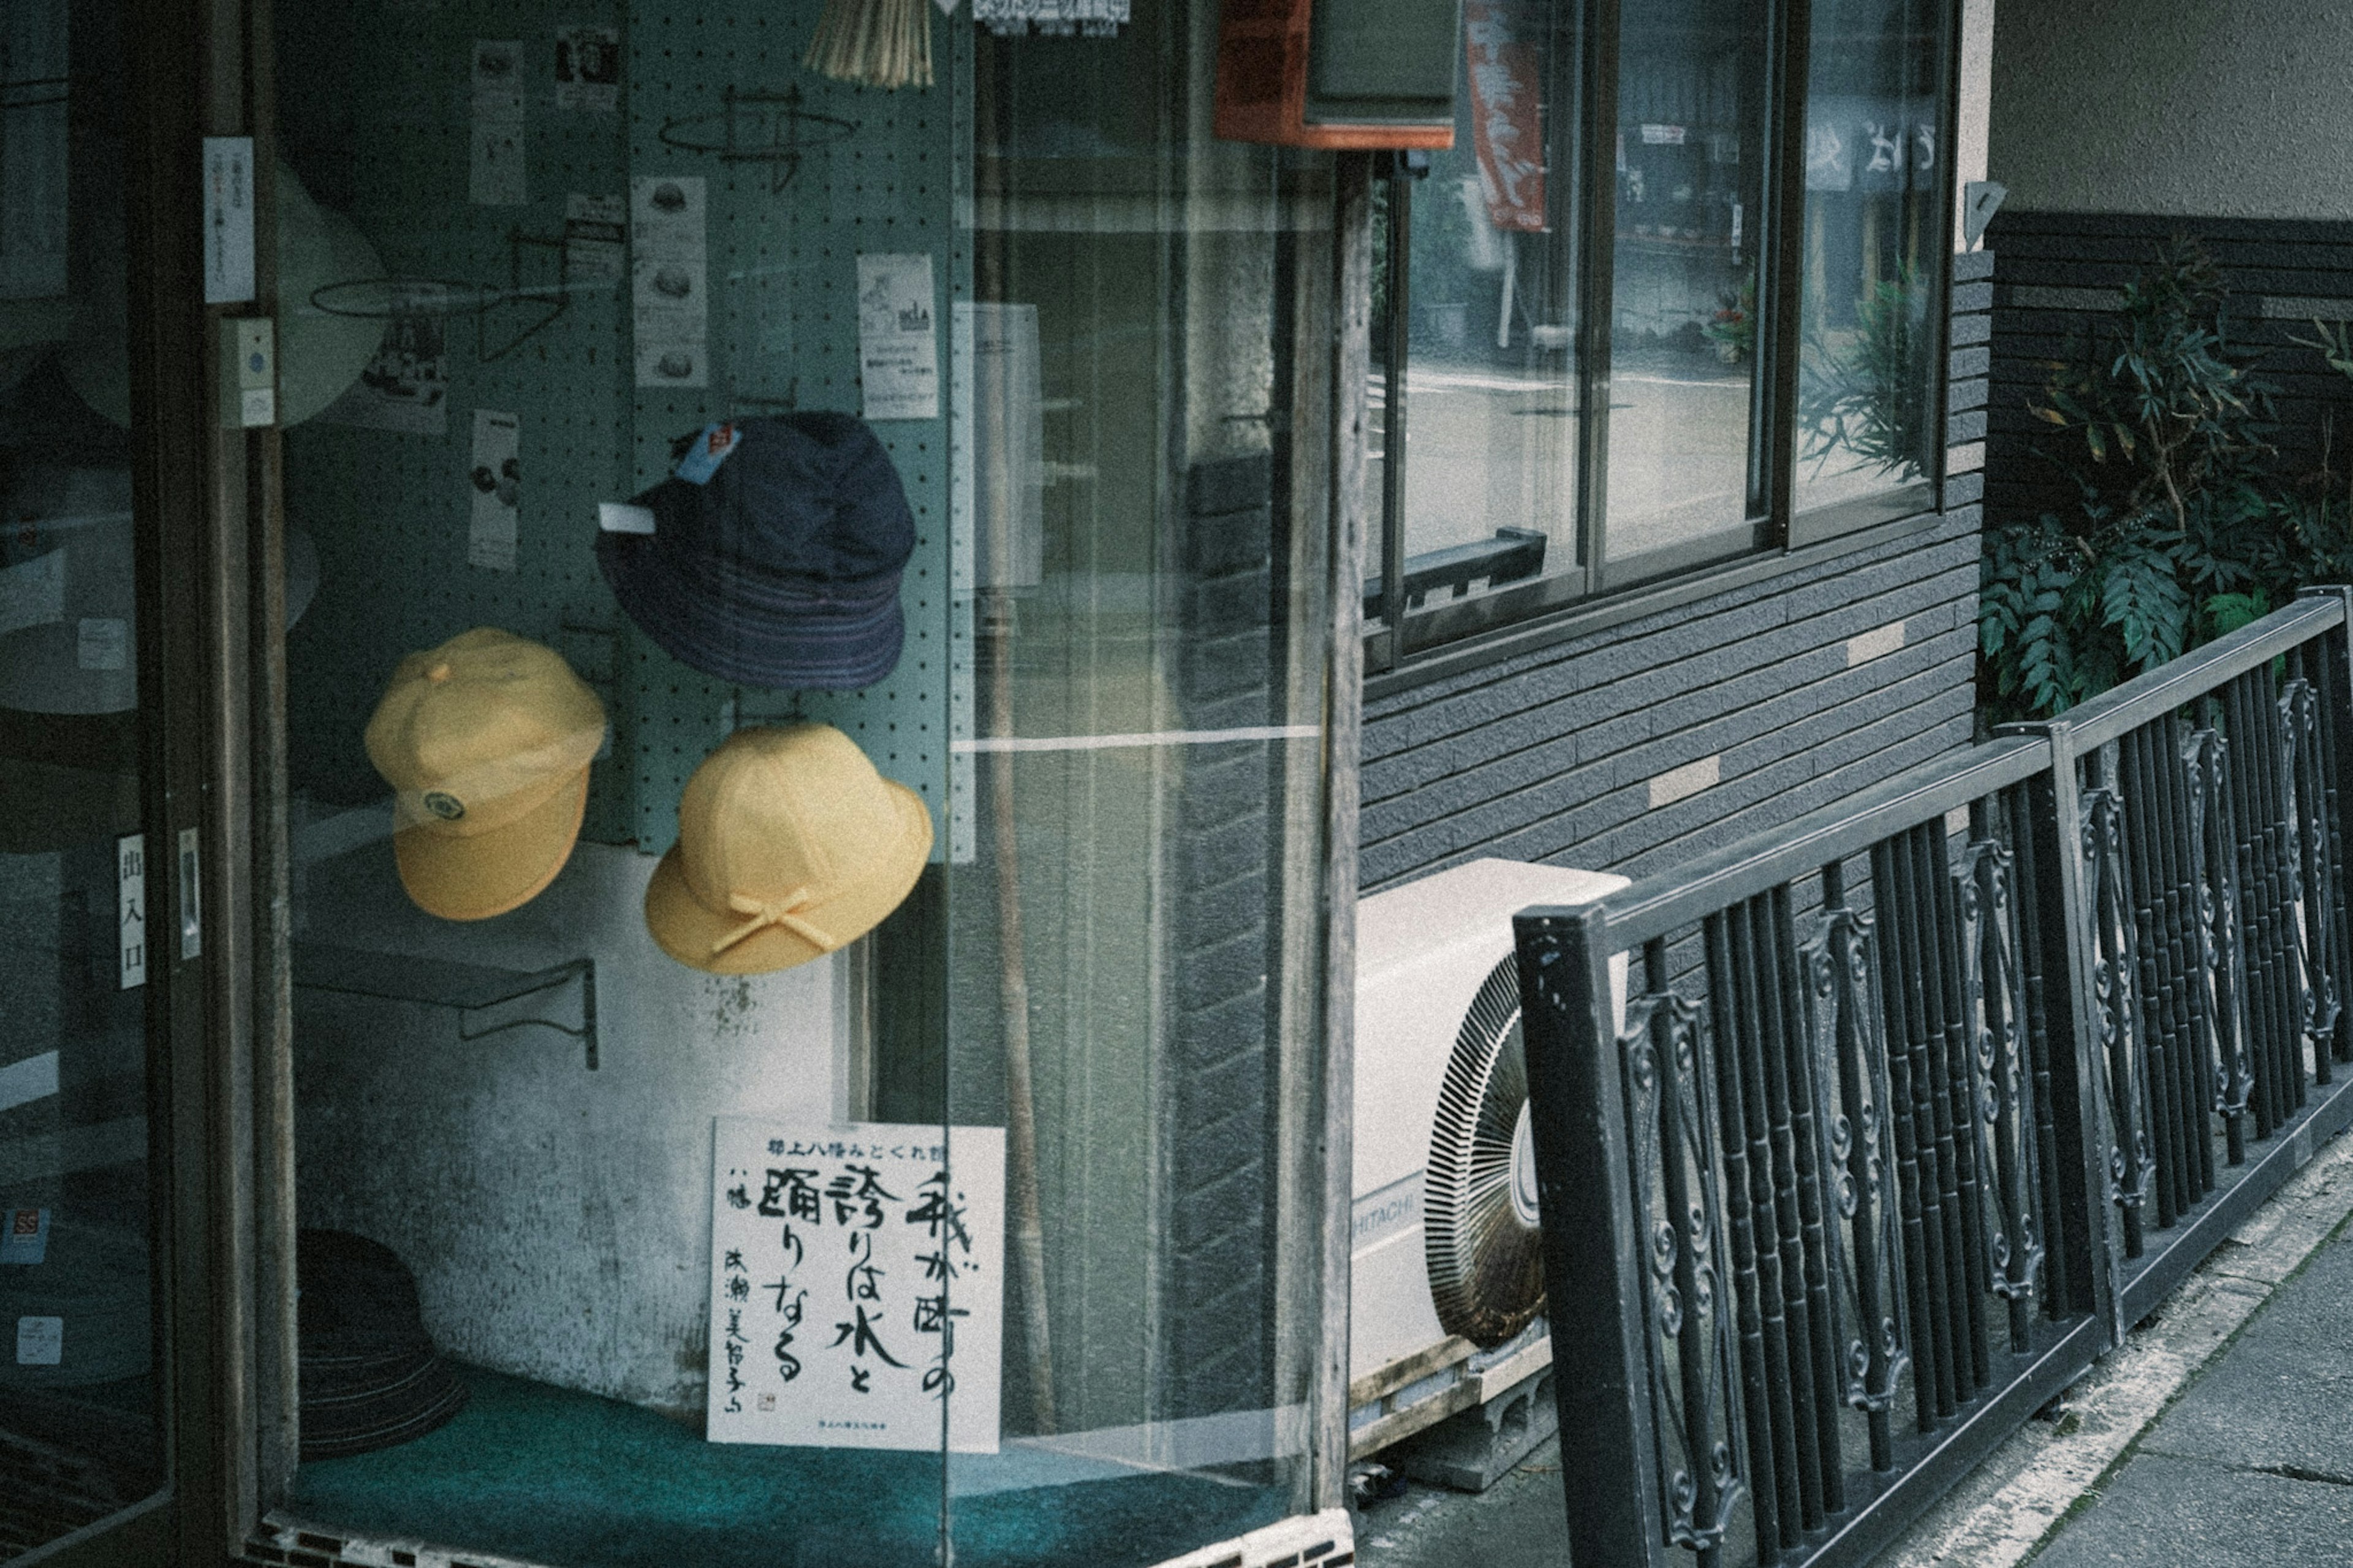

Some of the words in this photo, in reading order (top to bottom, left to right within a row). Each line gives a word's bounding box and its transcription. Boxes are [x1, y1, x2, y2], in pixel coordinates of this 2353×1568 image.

[123, 850, 142, 972] 出入口
[757, 1167, 820, 1382] 踊りなる
[824, 1164, 913, 1393] 誇りは水と
[906, 1170, 979, 1396] 我が町の
[1352, 1193, 1413, 1237] HITACHI
